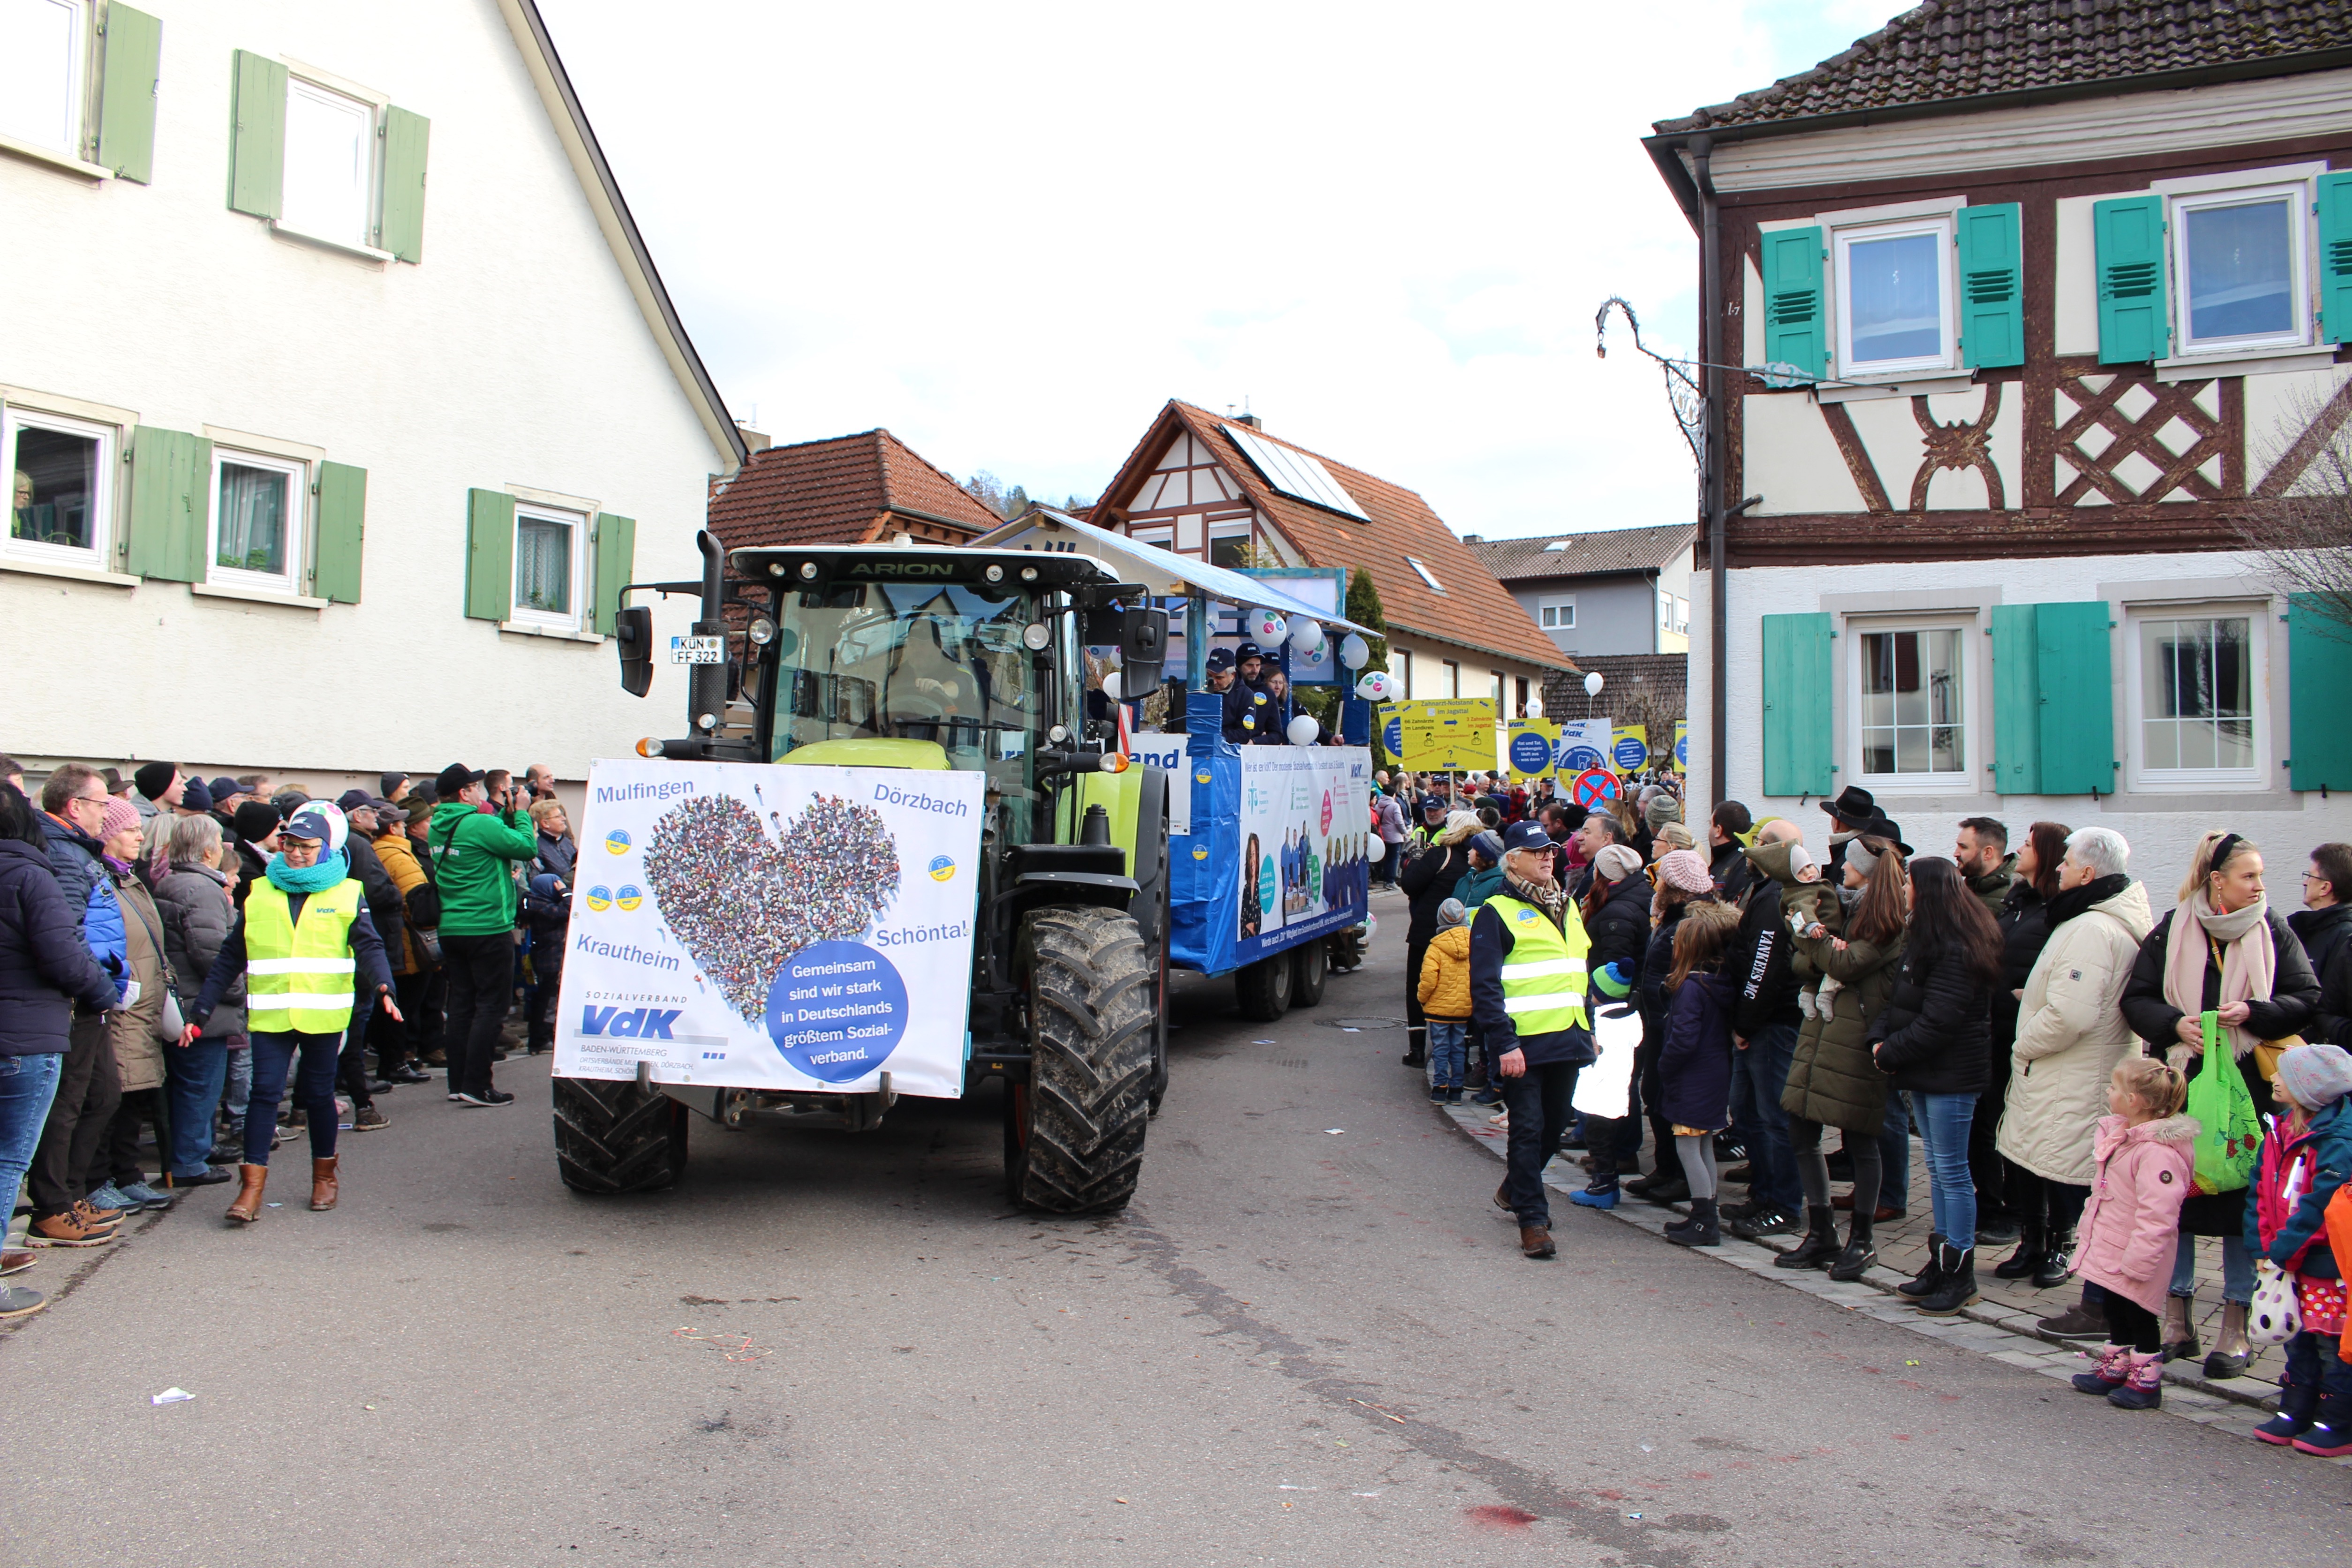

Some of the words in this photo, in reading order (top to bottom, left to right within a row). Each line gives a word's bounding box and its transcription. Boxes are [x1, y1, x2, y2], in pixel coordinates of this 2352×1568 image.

[850, 564, 953, 575] ARION
[681, 639, 704, 649] KÜN
[678, 651, 692, 663] FF
[696, 651, 717, 662] 322
[1562, 729, 1583, 738] VdK
[1129, 749, 1179, 769] and
[1447, 750, 1453, 758] ?
[1350, 764, 1362, 777] VdK
[597, 781, 694, 803] Mulfingen
[874, 784, 967, 817] Dörzbach
[1527, 828, 1542, 836] VdK
[876, 920, 968, 946] Schöntal
[1261, 937, 1272, 948] Werde
[576, 934, 679, 971] Krautheim
[1750, 930, 1775, 982] YANKEES
[792, 960, 876, 978] Gemeinsam
[586, 991, 687, 1003] SOZIALVERBAND
[789, 986, 818, 1001] sind
[822, 984, 843, 997] wir
[846, 979, 882, 995] stark
[1744, 981, 1759, 1000] MC
[781, 1011, 793, 1024] in
[798, 1001, 893, 1022] Deutschlands
[582, 1005, 684, 1040] VdK
[784, 1029, 844, 1049] größtem
[847, 1023, 893, 1039] Sozial-
[580, 1045, 668, 1056] BADEN-WÜRTTEMBERG
[810, 1047, 868, 1065] verband.
[578, 1065, 613, 1074] KRAUTHEIM,
[614, 1066, 638, 1075] SCHÖNT
[580, 1057, 624, 1066] ORTSVERBÄNDE
[660, 1061, 694, 1071] DÖRZBACH,
